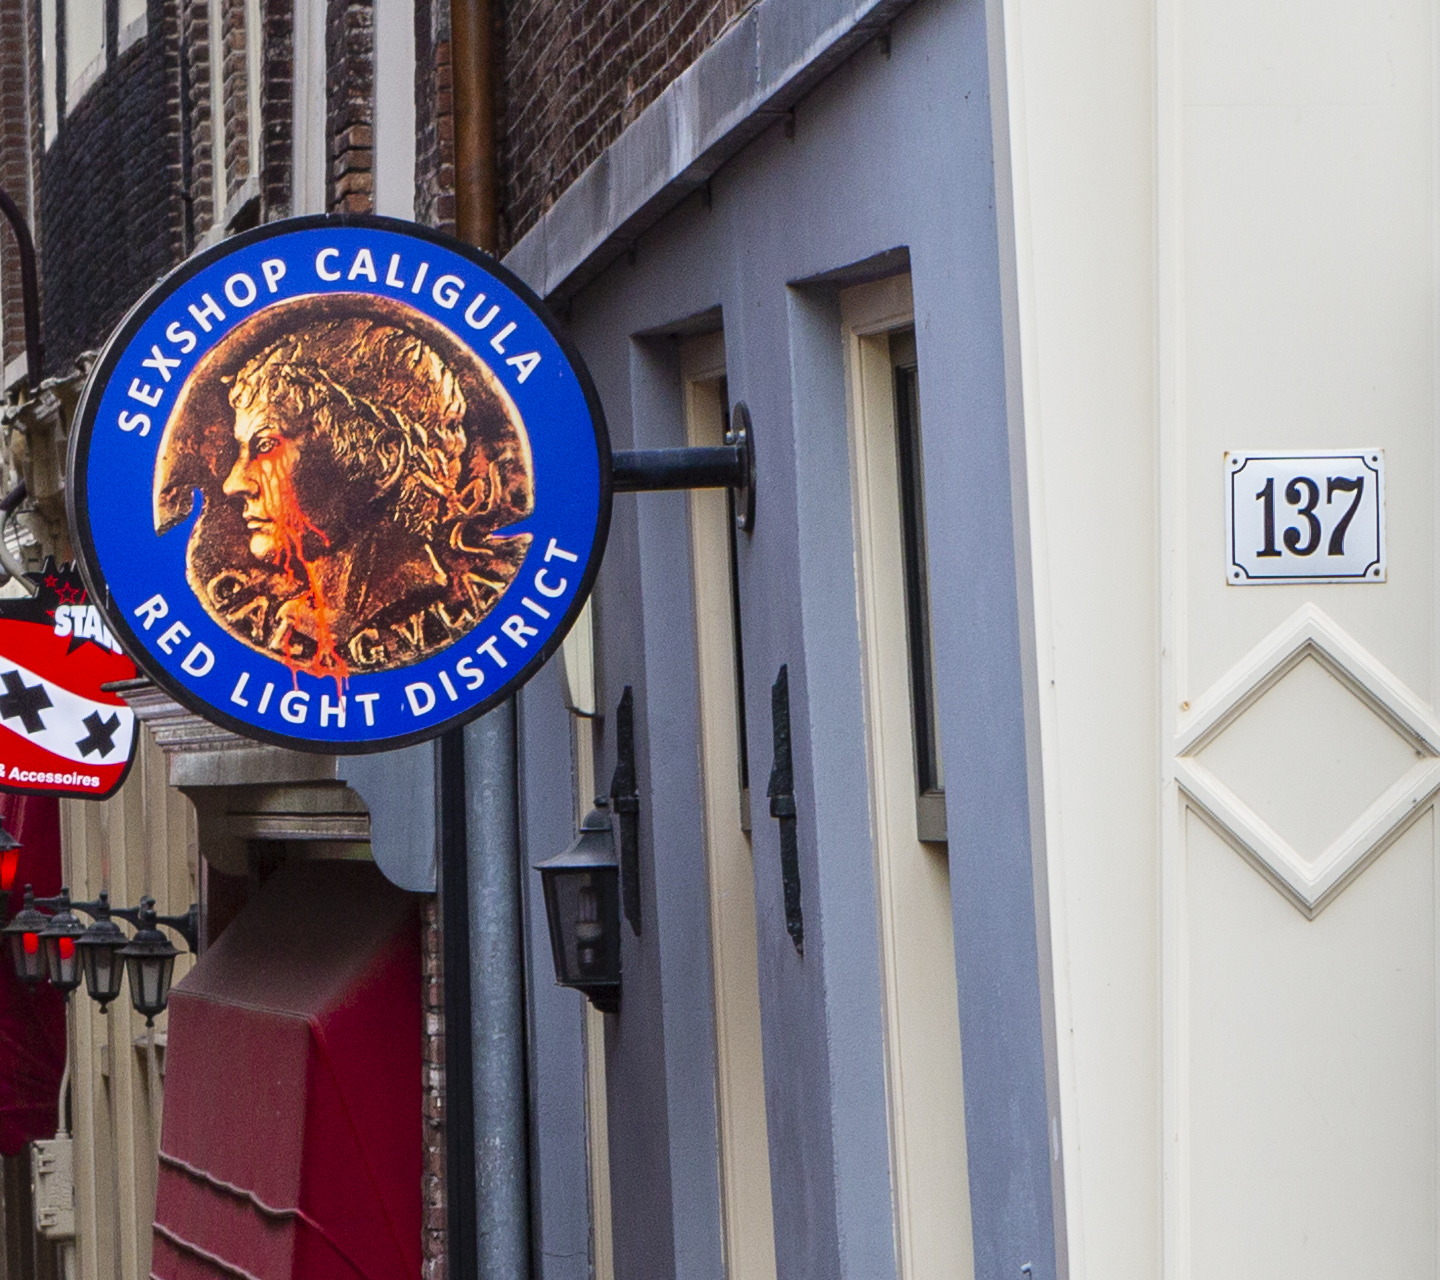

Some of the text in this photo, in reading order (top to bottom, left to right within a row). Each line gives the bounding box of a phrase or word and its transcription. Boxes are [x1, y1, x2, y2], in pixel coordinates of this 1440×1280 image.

[117, 248, 541, 437] SEXSHOP CALIGULA
[1256, 476, 1364, 557] 137
[133, 538, 578, 729] RED LIGHT DISTRICT
[8, 767, 100, 787] Accessoires
